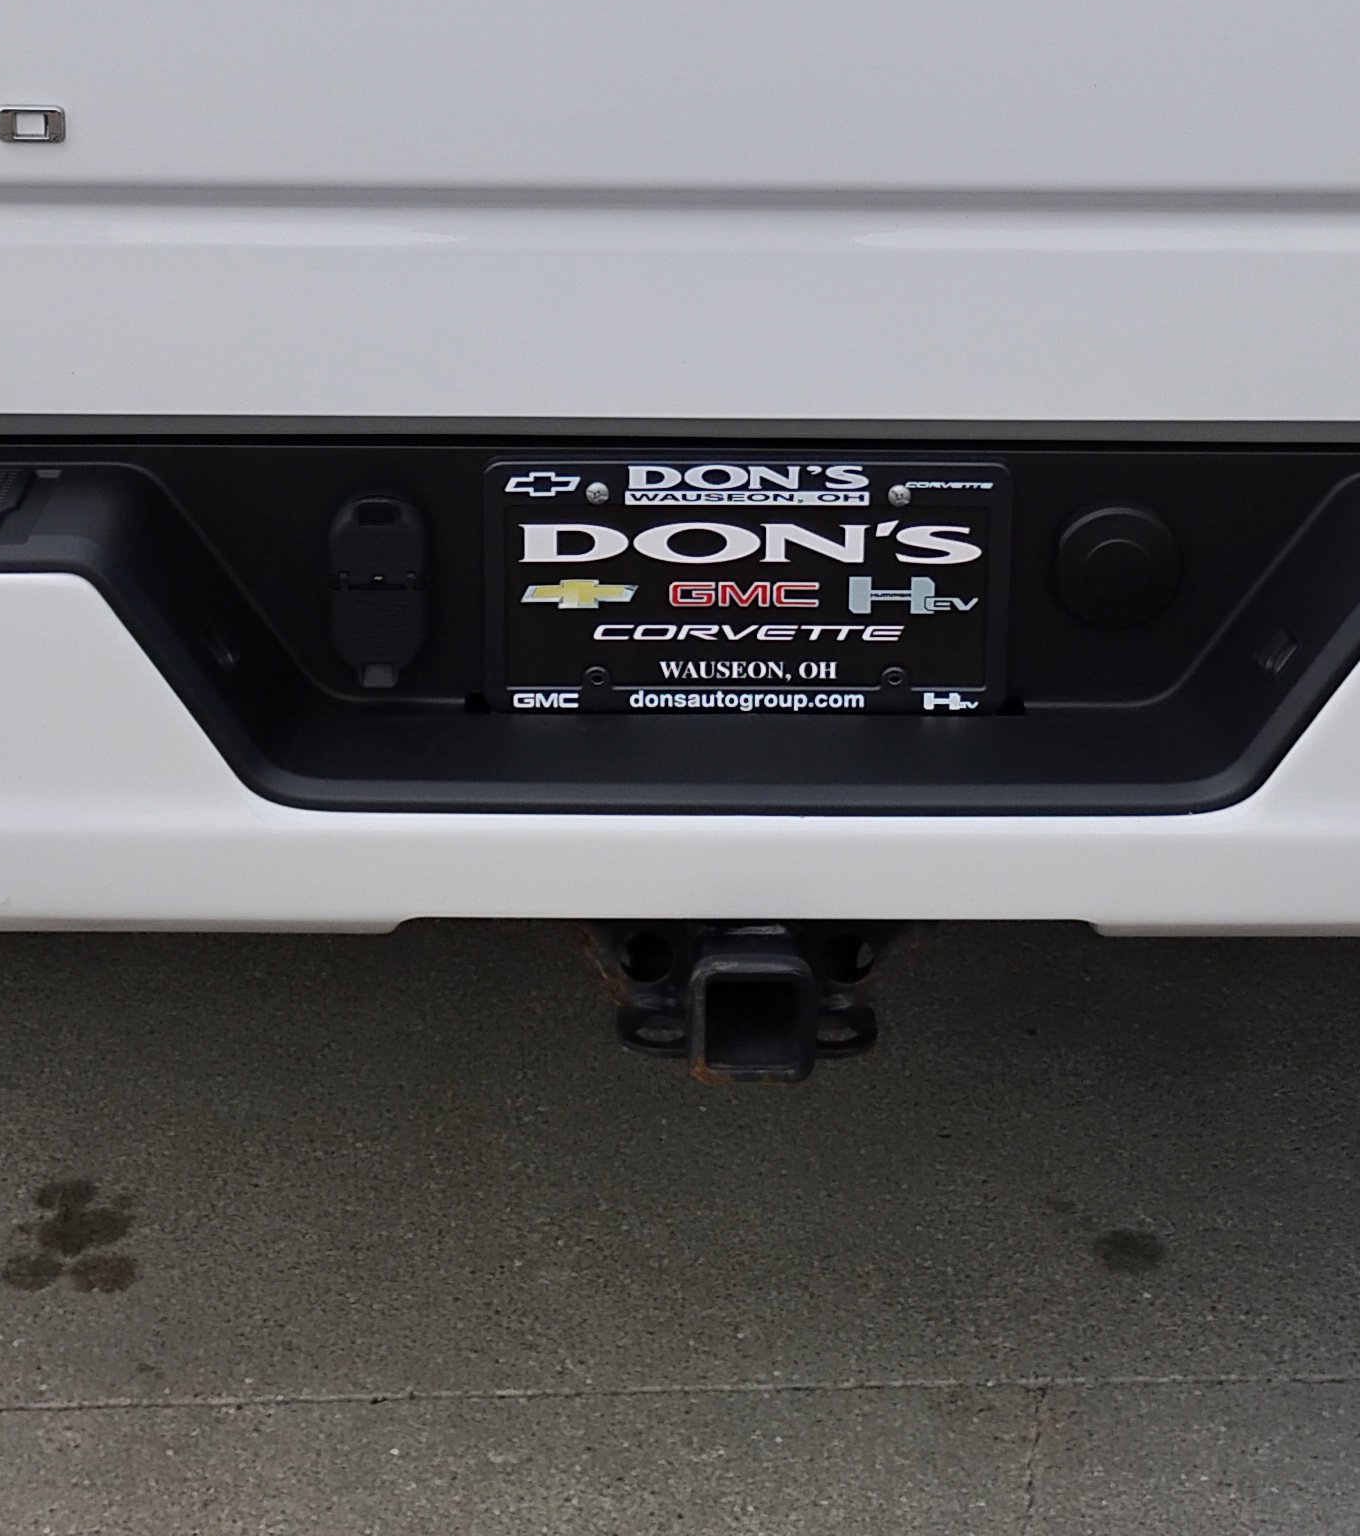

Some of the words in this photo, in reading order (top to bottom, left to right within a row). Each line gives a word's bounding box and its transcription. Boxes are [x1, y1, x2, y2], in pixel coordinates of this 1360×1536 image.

[627, 465, 870, 491] DON'S
[905, 481, 994, 489] CORVETTE
[629, 493, 806, 504] WAUSEON,
[816, 493, 866, 503] OH
[518, 520, 983, 565] DON'S
[668, 581, 820, 609] GMC
[592, 625, 905, 642] CORVETTE
[660, 661, 792, 683] WAUSEON,
[799, 661, 837, 680] OH
[512, 692, 579, 709] GMC
[629, 690, 865, 712] donsautogroup.com
